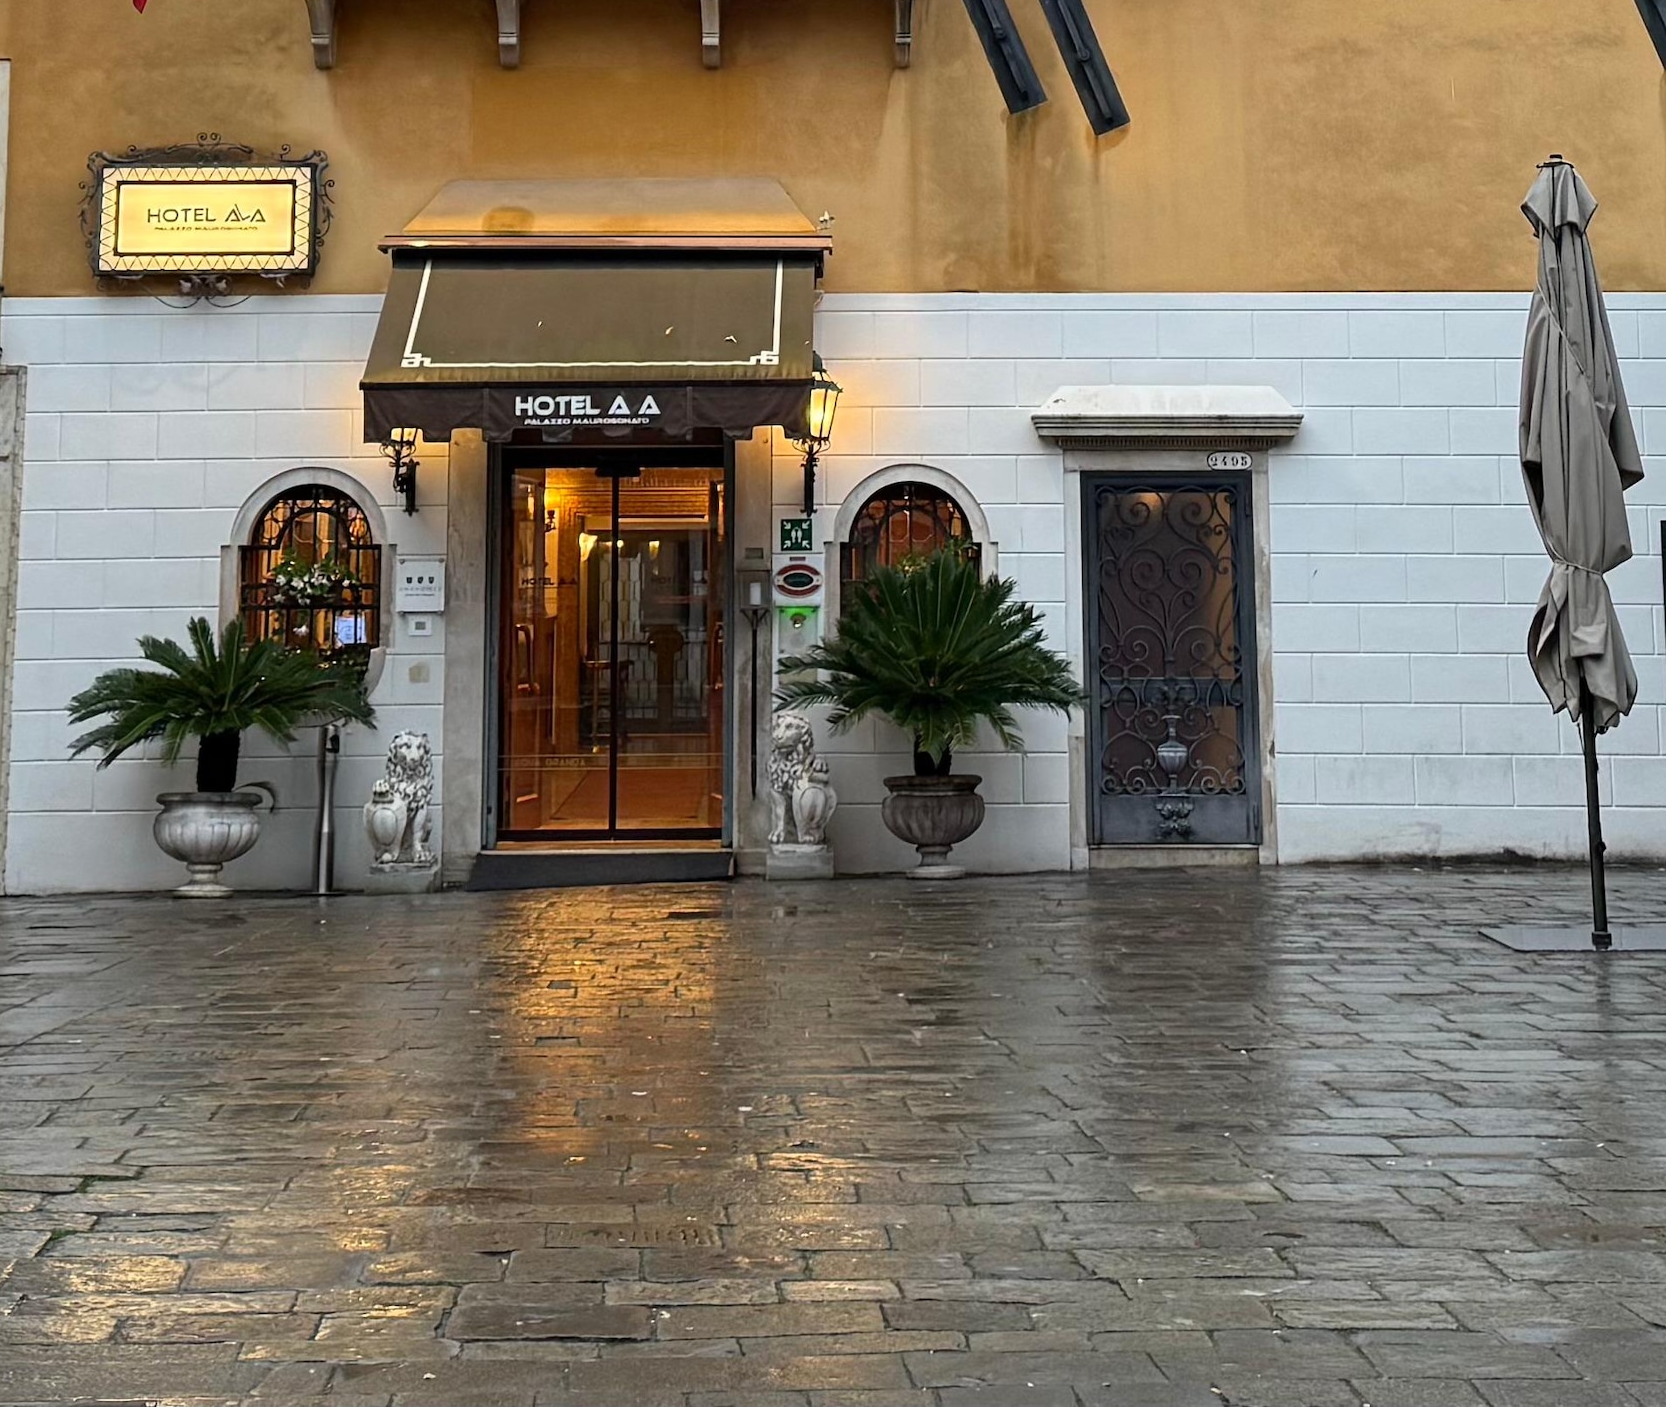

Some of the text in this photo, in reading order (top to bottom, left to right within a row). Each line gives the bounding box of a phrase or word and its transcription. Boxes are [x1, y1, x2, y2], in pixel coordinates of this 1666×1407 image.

[147, 207, 217, 224] HOTEL
[514, 394, 602, 417] HOTEL
[524, 417, 572, 426] PALAZZO
